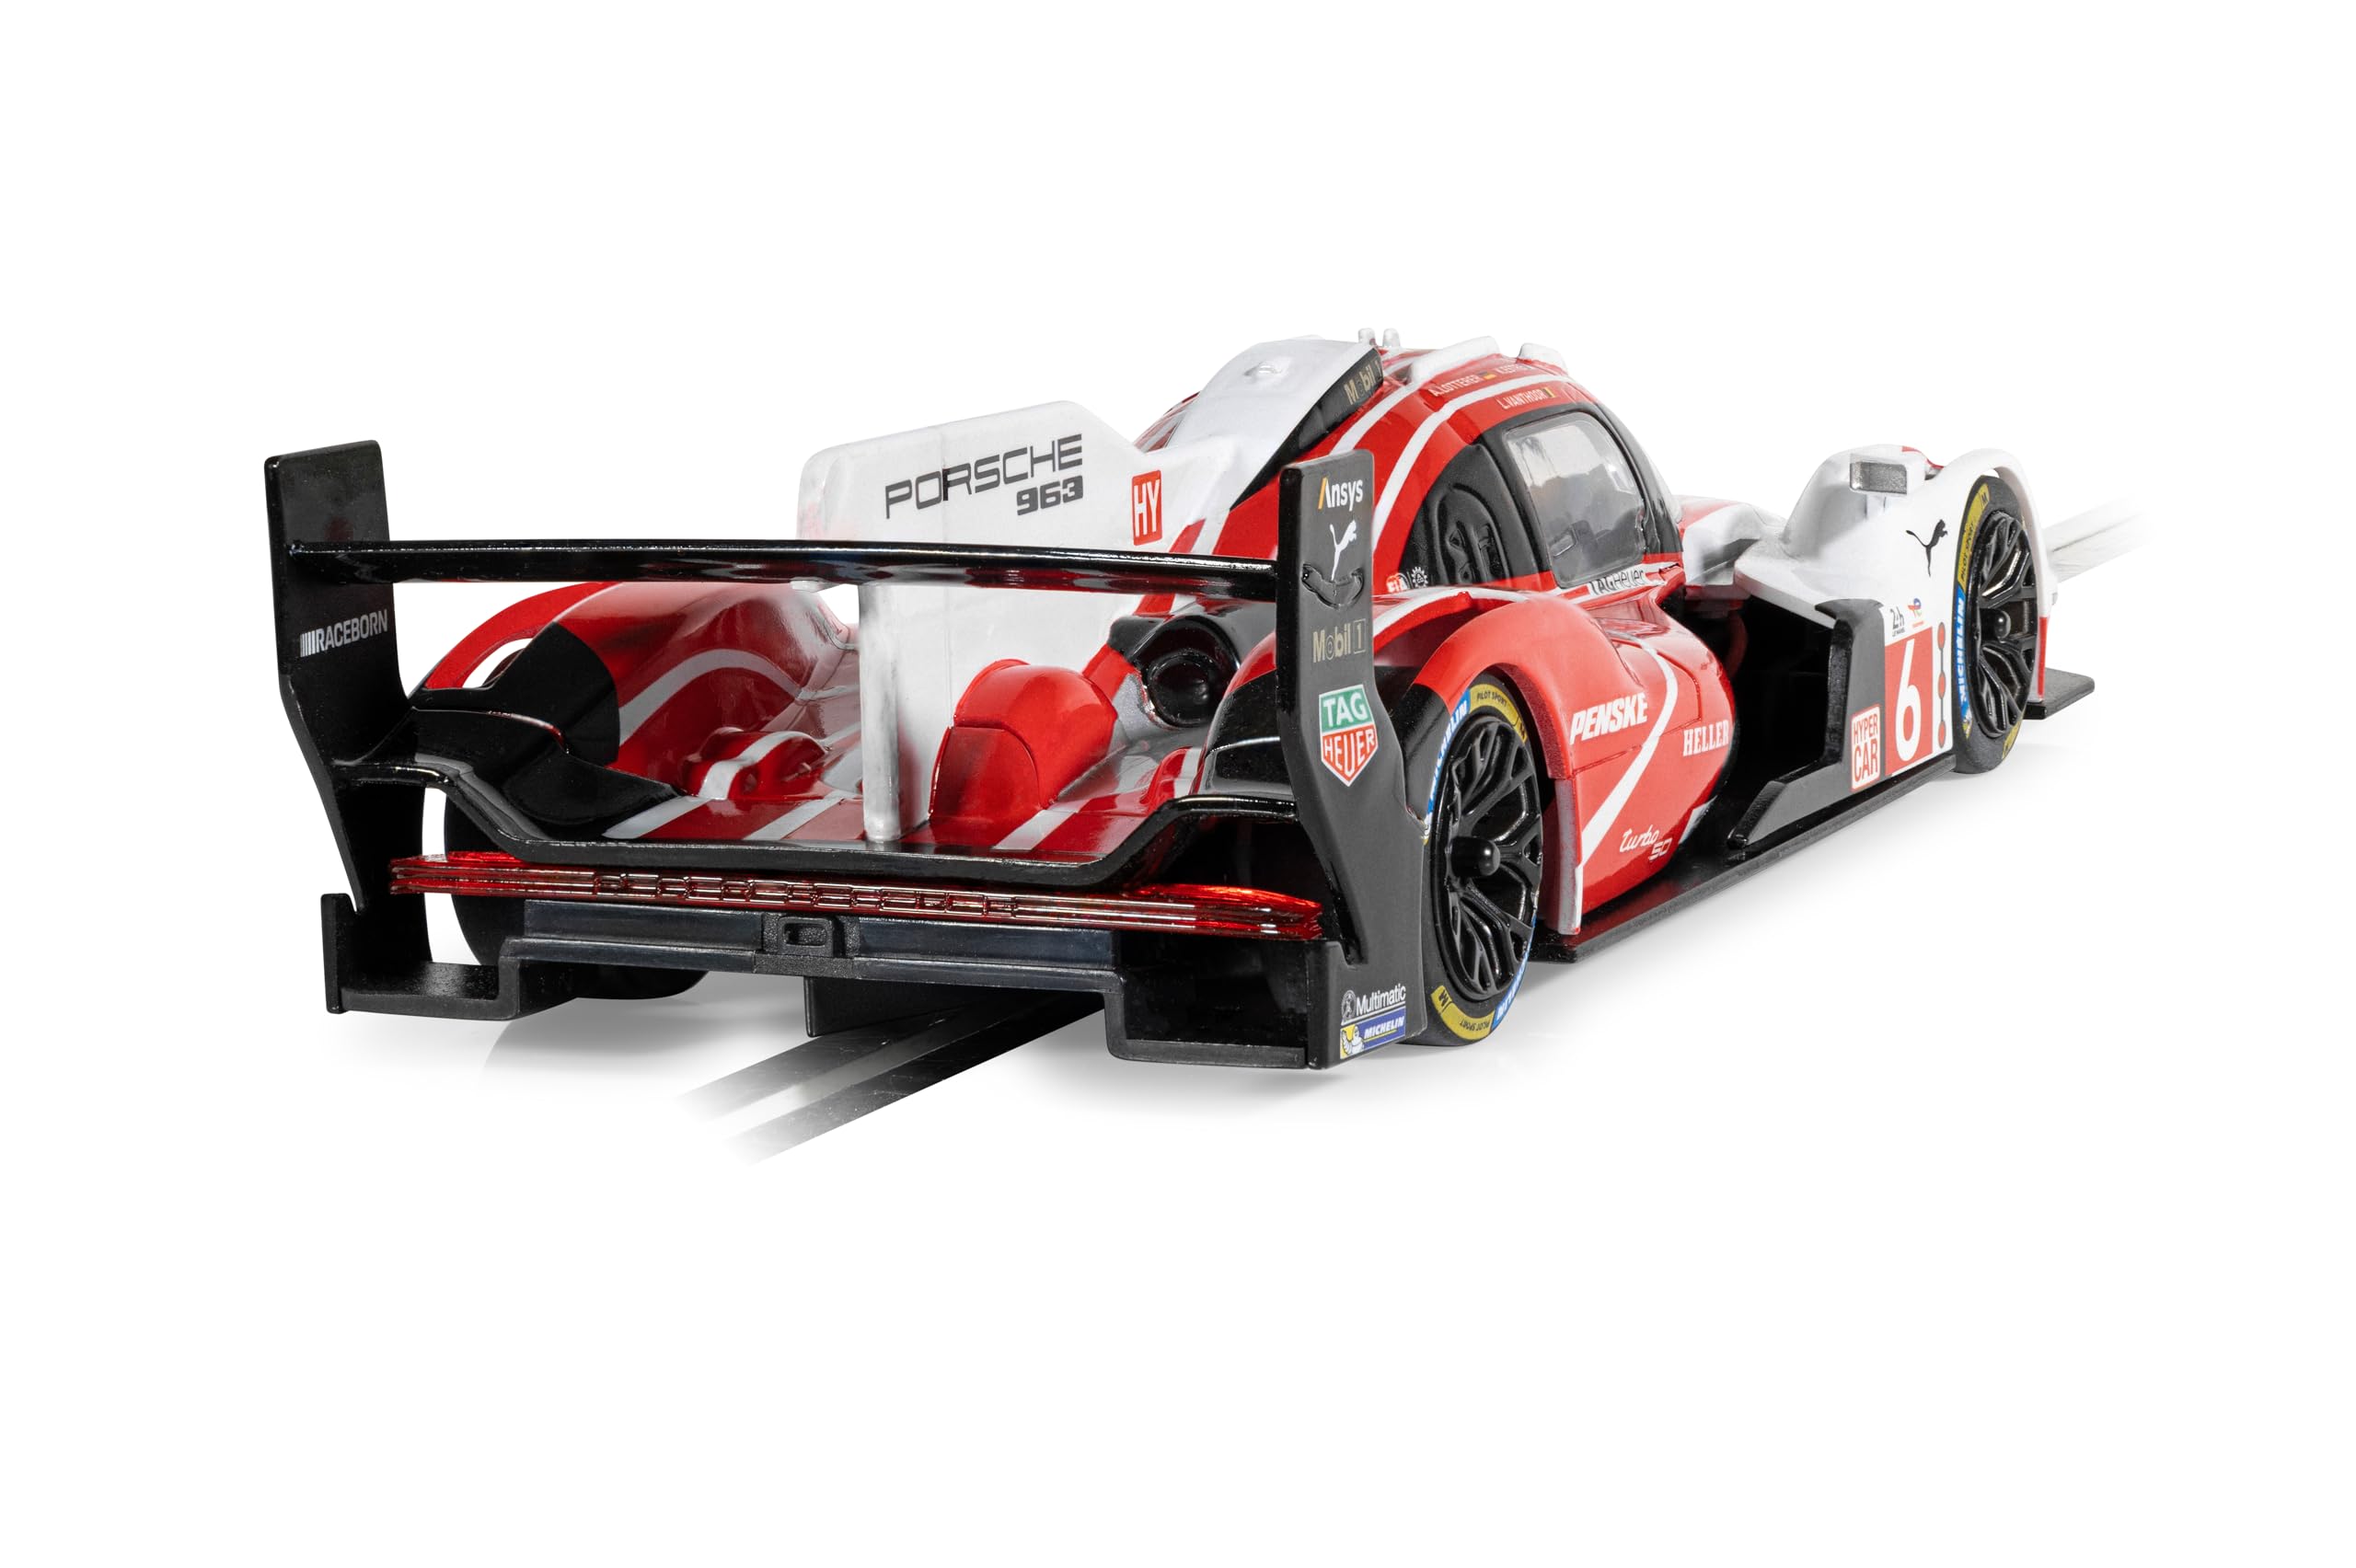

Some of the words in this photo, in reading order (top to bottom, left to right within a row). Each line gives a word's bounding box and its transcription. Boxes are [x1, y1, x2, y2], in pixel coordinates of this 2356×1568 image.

[1344, 364, 1376, 406] Mobil
[884, 433, 1083, 519] PORSCHE
[1016, 475, 1084, 515] 963
[1318, 477, 1363, 512] Ansys
[1133, 478, 1161, 537] HY
[316, 608, 387, 653] RACEBORN
[1312, 626, 1352, 663] Mobil
[1956, 597, 1968, 704] MICHELIN
[1322, 692, 1368, 728] TAG
[1476, 690, 1491, 702] PILOT
[1895, 638, 1923, 762] 6
[1569, 692, 1648, 745] PENSKE
[1682, 720, 1729, 757] HELLER
[1853, 712, 1879, 743] HYPER
[1323, 728, 1375, 776] HEUER
[1854, 741, 1879, 782] CAR
[1356, 982, 1406, 1017] Multimatic
[1364, 1016, 1404, 1039] MICHELIN
